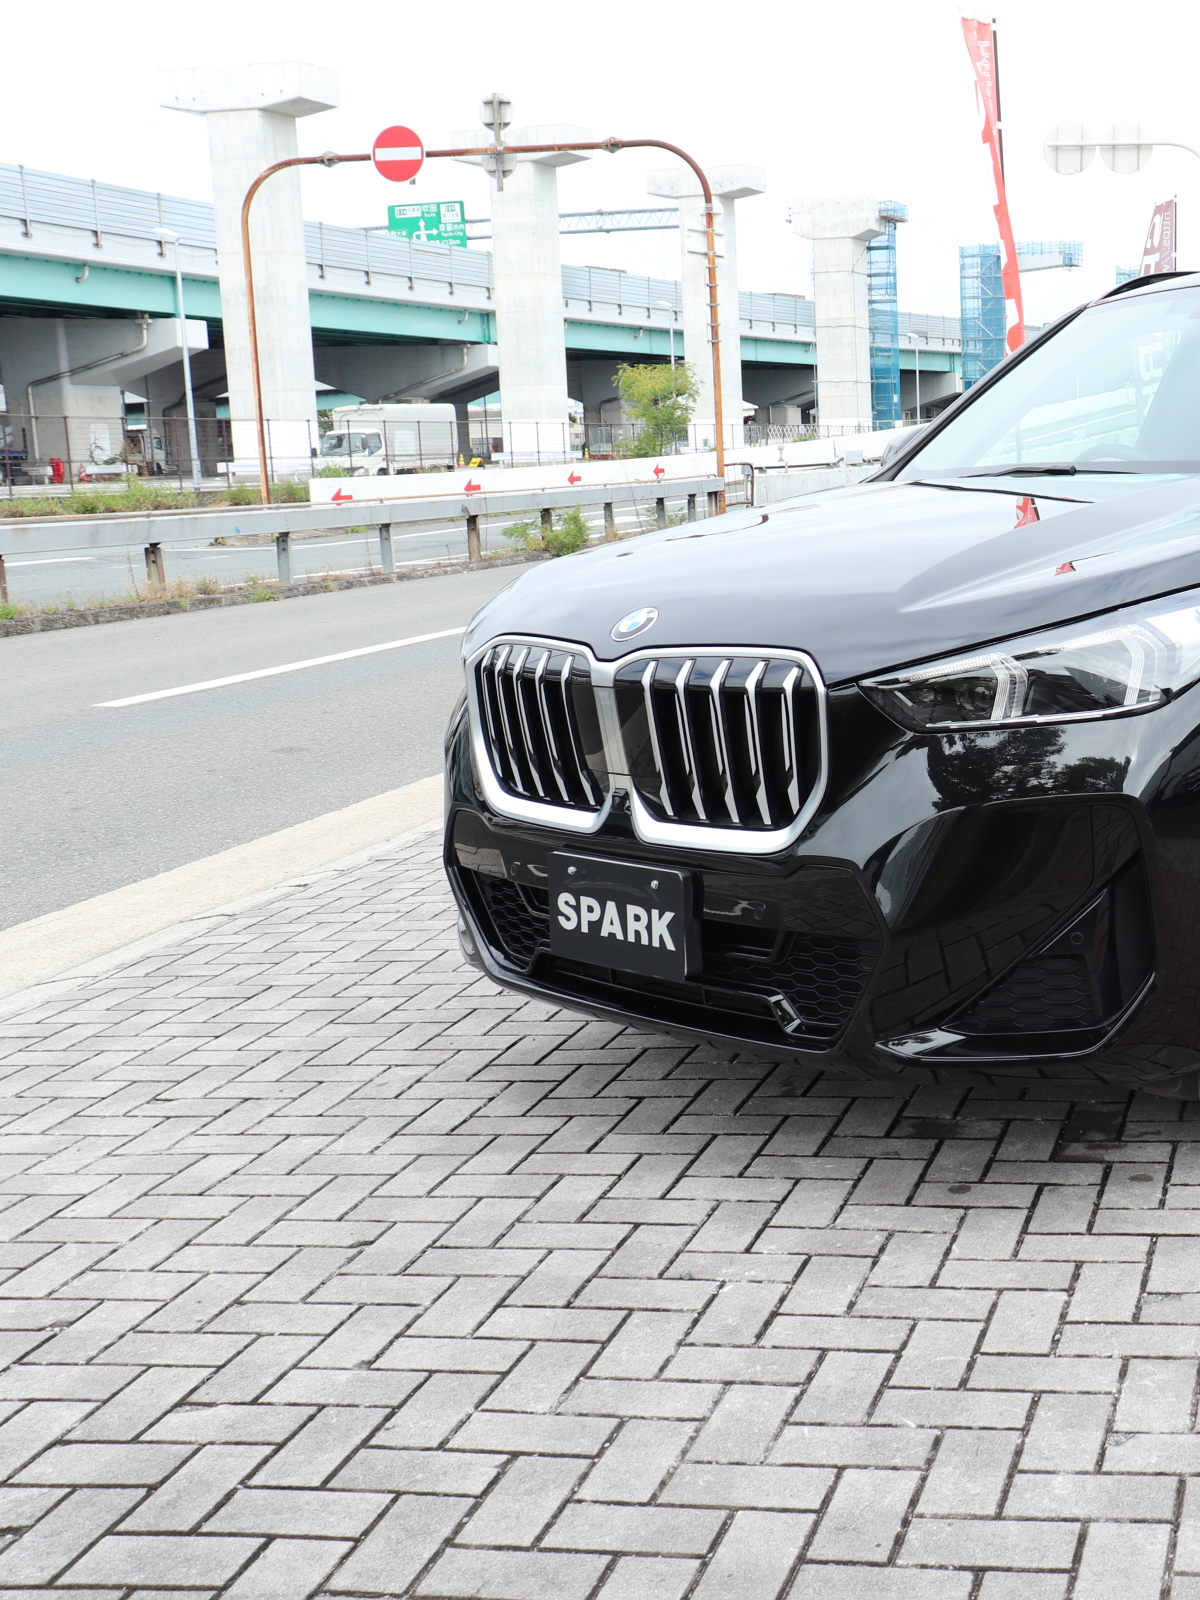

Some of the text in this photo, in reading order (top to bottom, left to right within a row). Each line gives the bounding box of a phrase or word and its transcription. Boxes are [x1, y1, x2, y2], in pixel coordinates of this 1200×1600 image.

[422, 204, 437, 212] 吹田
[439, 224, 464, 232] 京都市内
[557, 892, 676, 952] SPARK
